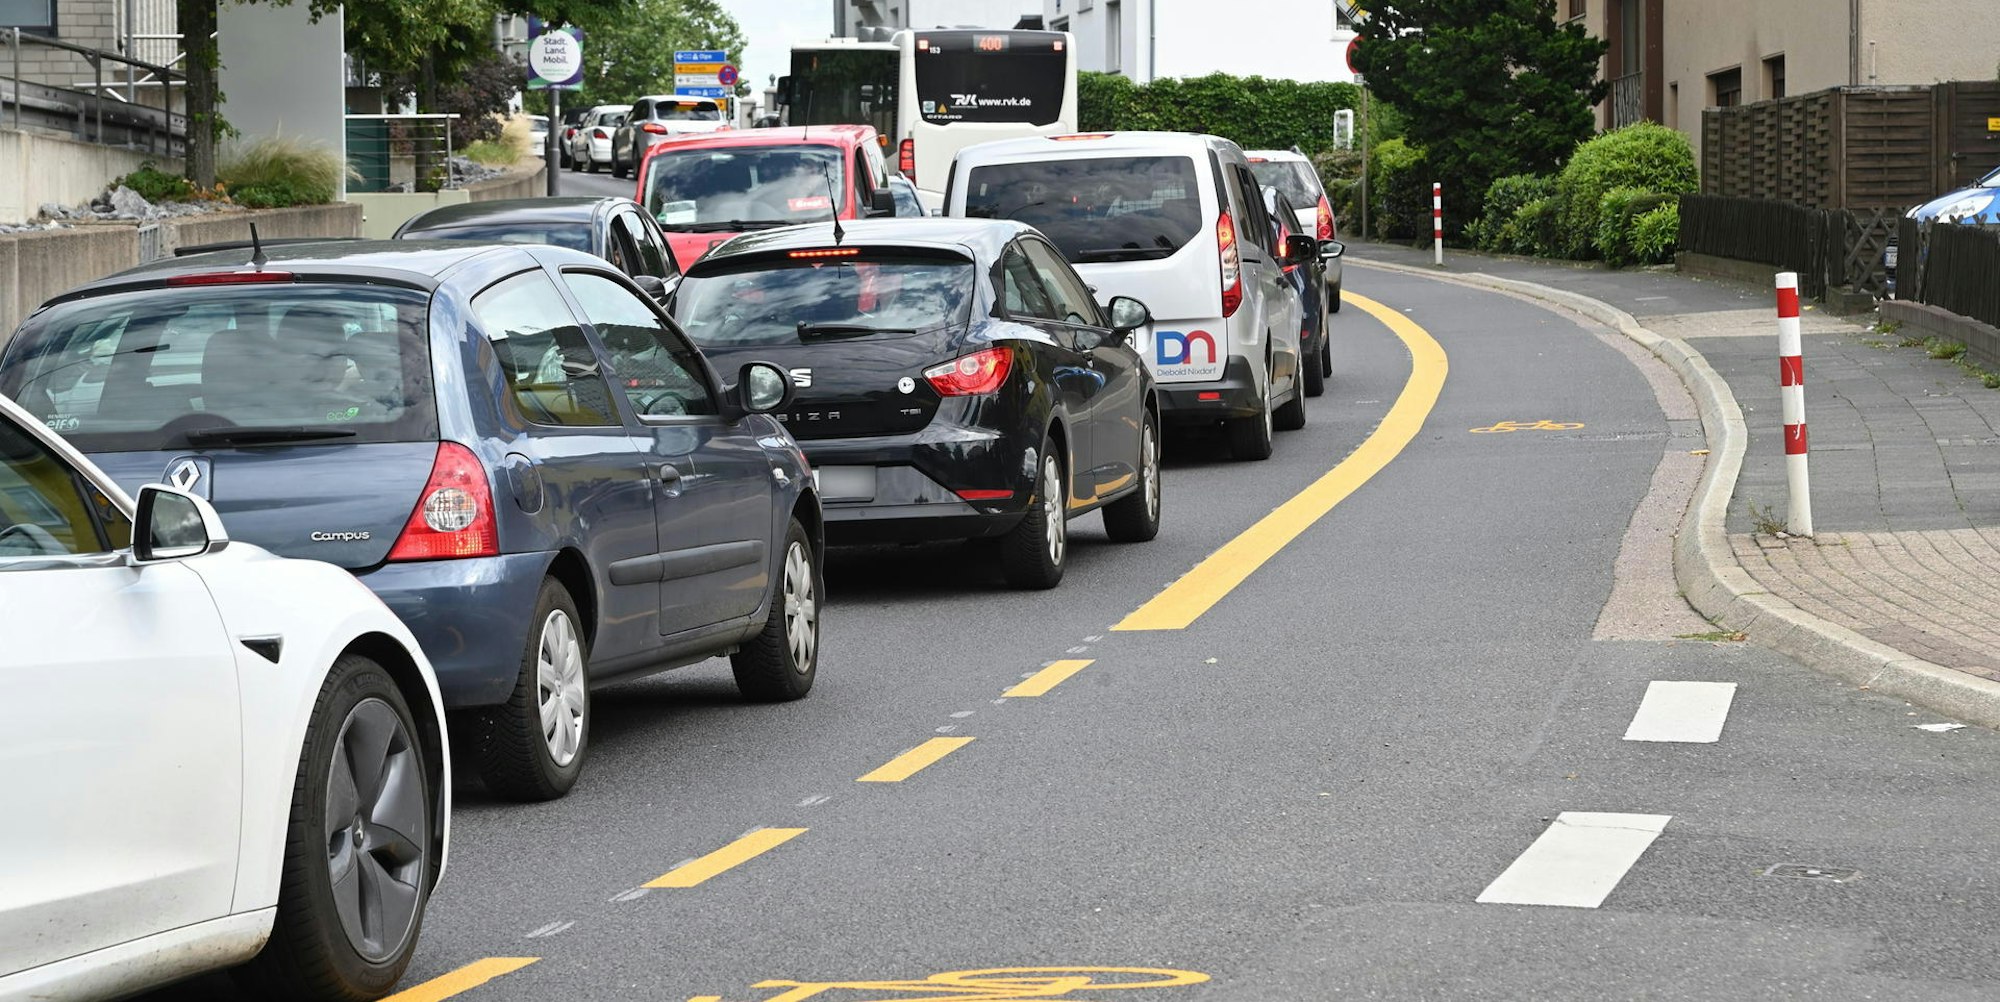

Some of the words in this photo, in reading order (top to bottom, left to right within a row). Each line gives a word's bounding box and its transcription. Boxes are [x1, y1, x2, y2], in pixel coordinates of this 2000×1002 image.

[543, 37, 568, 46] Stadt.
[979, 37, 1002, 50] 400
[544, 47, 567, 55] Land.
[543, 56, 569, 64] Mobil.
[978, 97, 1032, 106] www.rvk.de
[1156, 368, 1186, 377] Diebold
[1187, 367, 1217, 376] Nixdorf
[775, 411, 841, 422] BIZA
[311, 531, 370, 542] Campus
